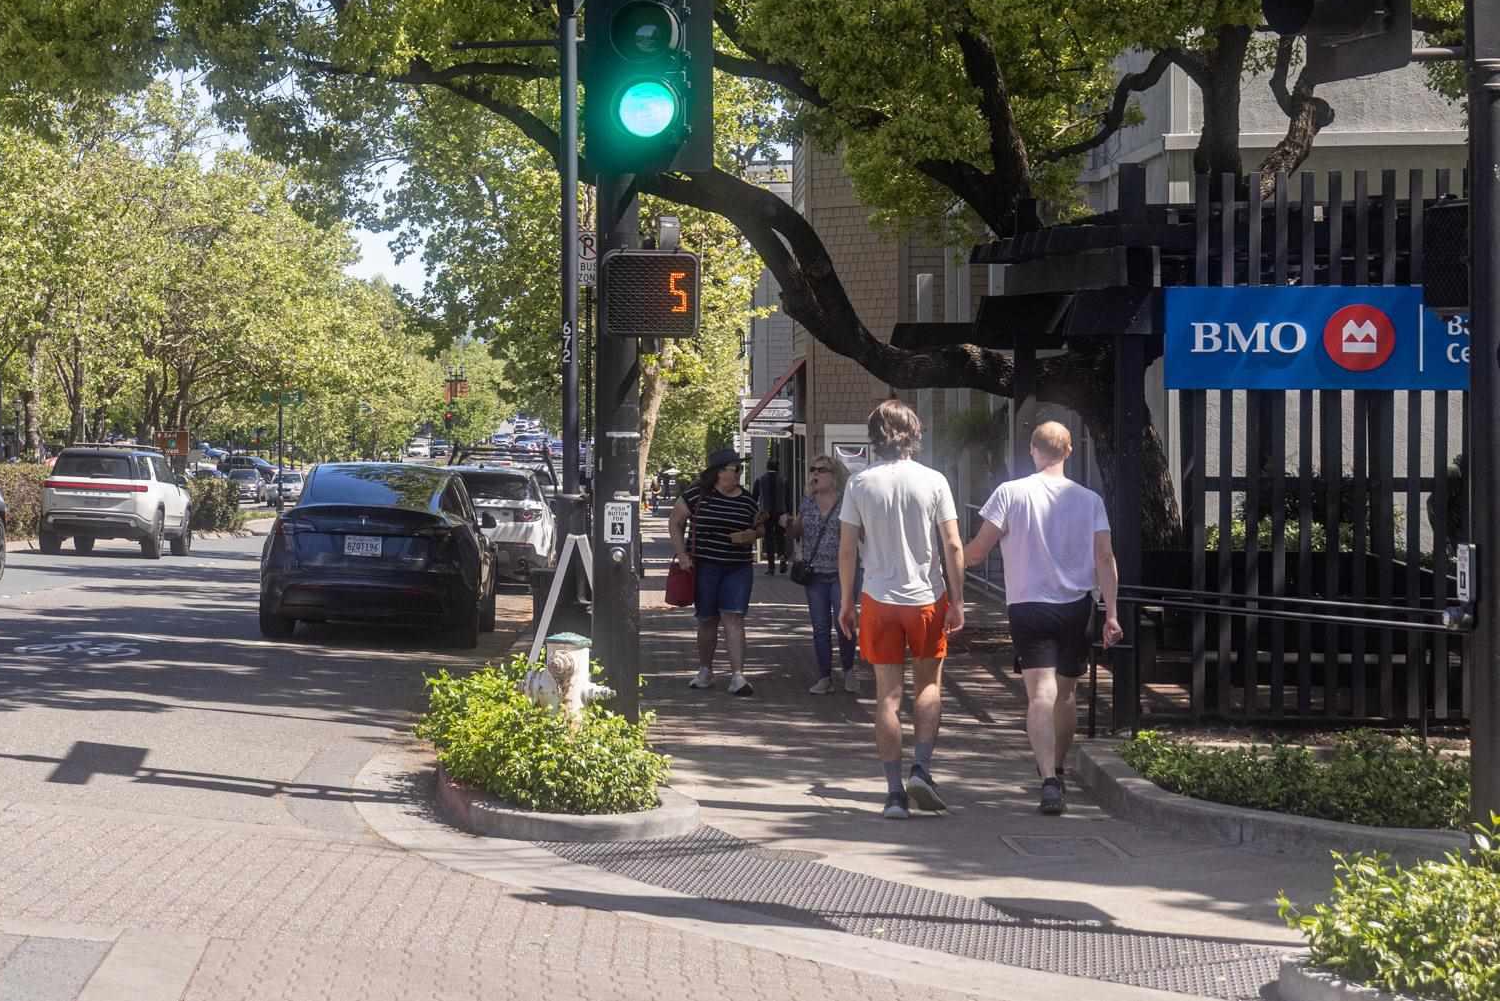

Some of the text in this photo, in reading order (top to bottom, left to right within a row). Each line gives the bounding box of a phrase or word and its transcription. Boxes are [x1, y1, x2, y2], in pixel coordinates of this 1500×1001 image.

[669, 272, 688, 313] 5
[562, 321, 572, 363] 672
[1190, 321, 1307, 354] BMO
